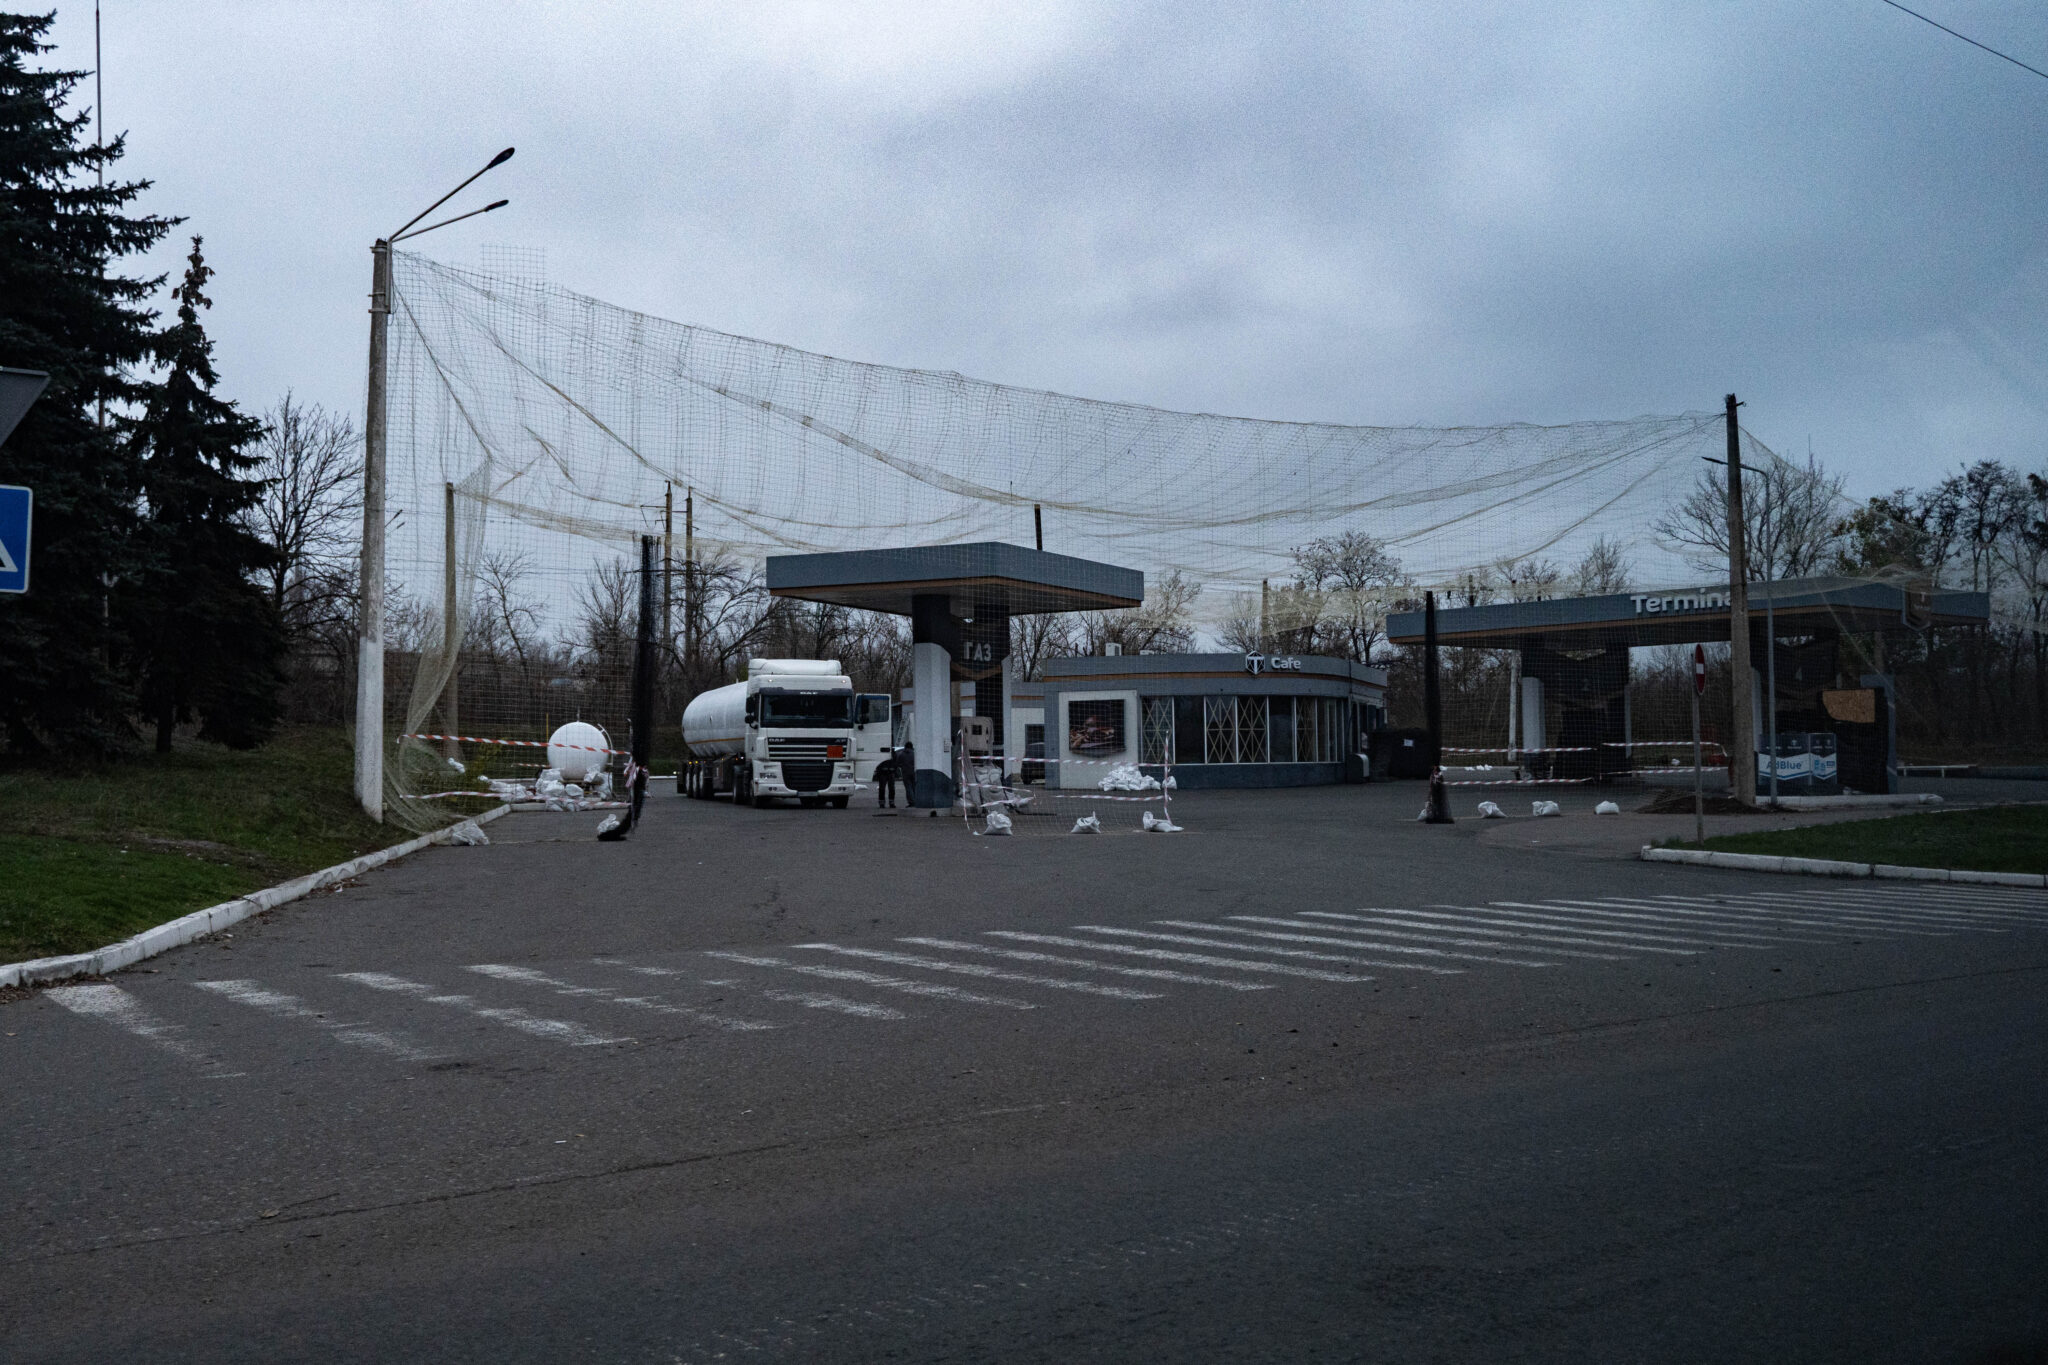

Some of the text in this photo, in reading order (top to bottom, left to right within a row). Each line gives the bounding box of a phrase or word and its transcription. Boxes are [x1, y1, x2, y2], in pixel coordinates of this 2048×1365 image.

[1630, 588, 1731, 613] Termin
[963, 641, 992, 662] ГАЗ
[1271, 657, 1302, 669] Cafe
[1766, 760, 1802, 770] AdBlue
